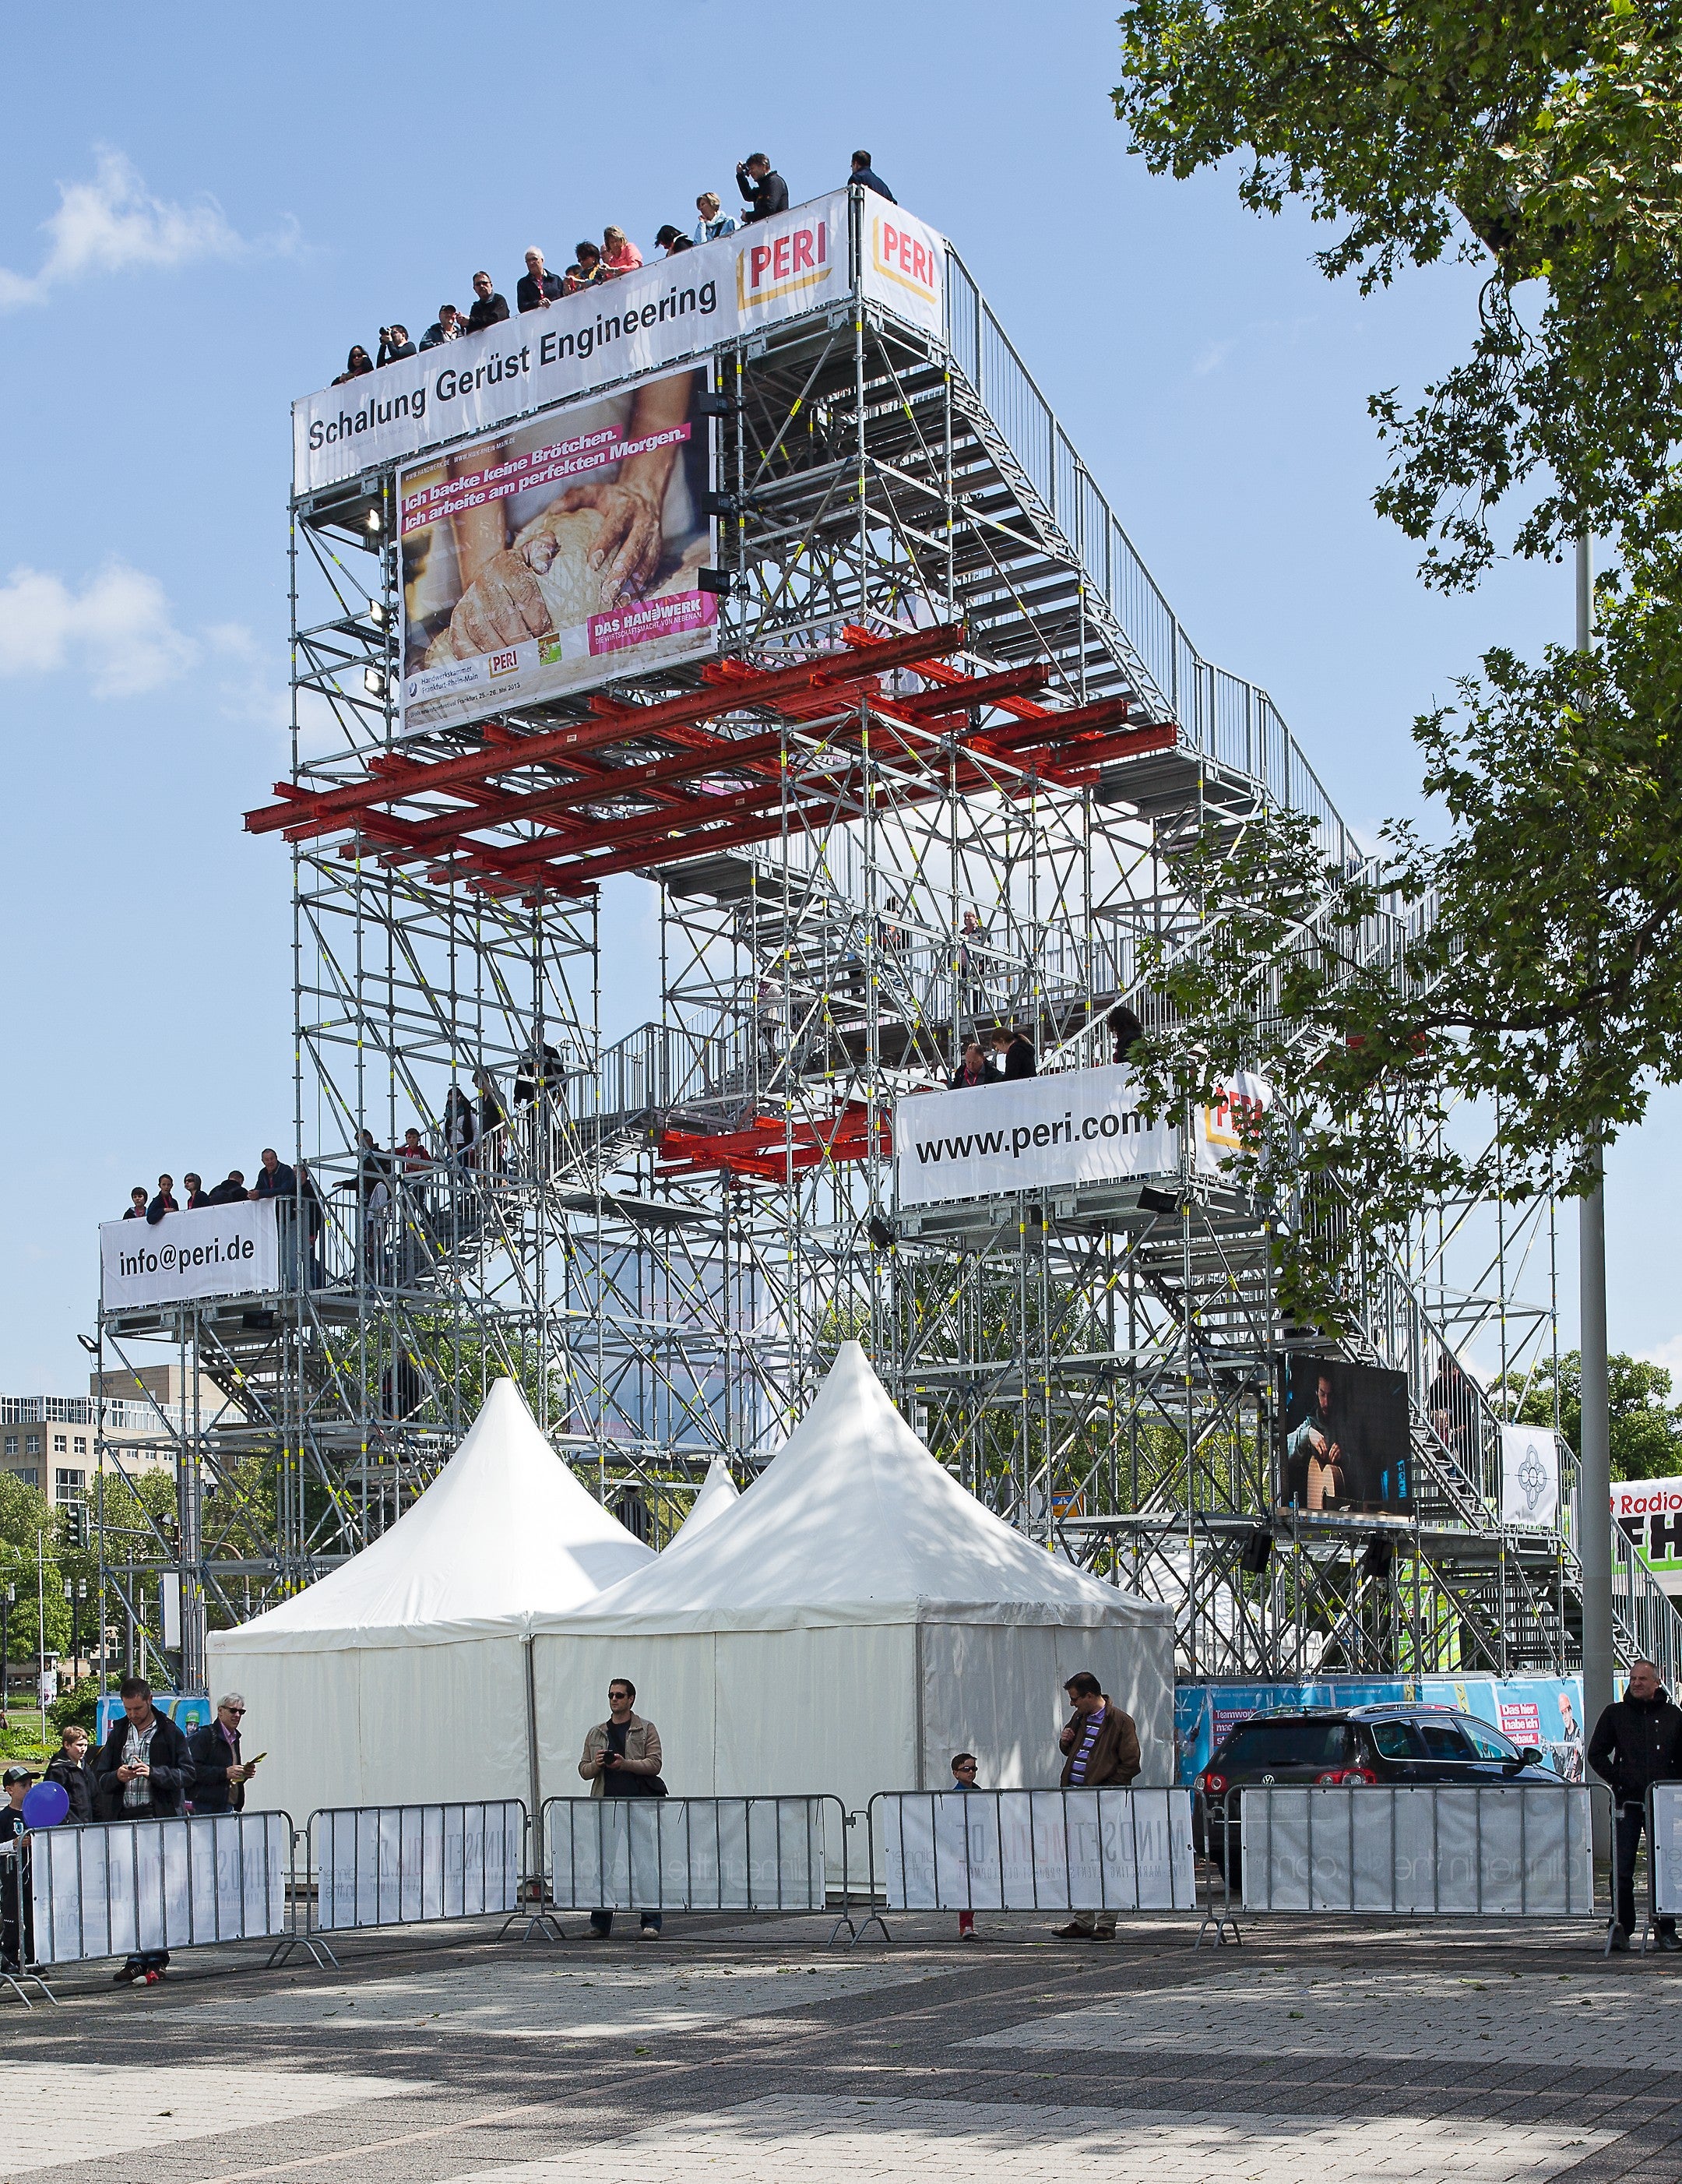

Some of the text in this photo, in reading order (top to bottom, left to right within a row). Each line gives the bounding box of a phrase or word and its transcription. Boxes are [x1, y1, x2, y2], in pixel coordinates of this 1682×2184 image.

[751, 222, 827, 290] PERI
[882, 222, 934, 289] PERI
[309, 388, 426, 451] Schalung
[435, 345, 530, 402] Gerüst
[540, 279, 717, 368] Engineering
[404, 430, 617, 512] Ich backe keine Brötchen.
[404, 428, 686, 531] Ich arbeite am perfekten Morgen.
[594, 619, 621, 637] DAS
[595, 636, 604, 645] DIE
[661, 619, 673, 628] VON
[492, 650, 518, 671] PERI
[420, 665, 473, 685] Handwerkskammer
[507, 682, 521, 692] 2013
[916, 1111, 1153, 1164] www.peri.com
[120, 1235, 255, 1276] info@peri.de
[1620, 1492, 1682, 1515] Radio
[1502, 1703, 1535, 1716] Das hier
[1504, 1717, 1539, 1730] habe ich
